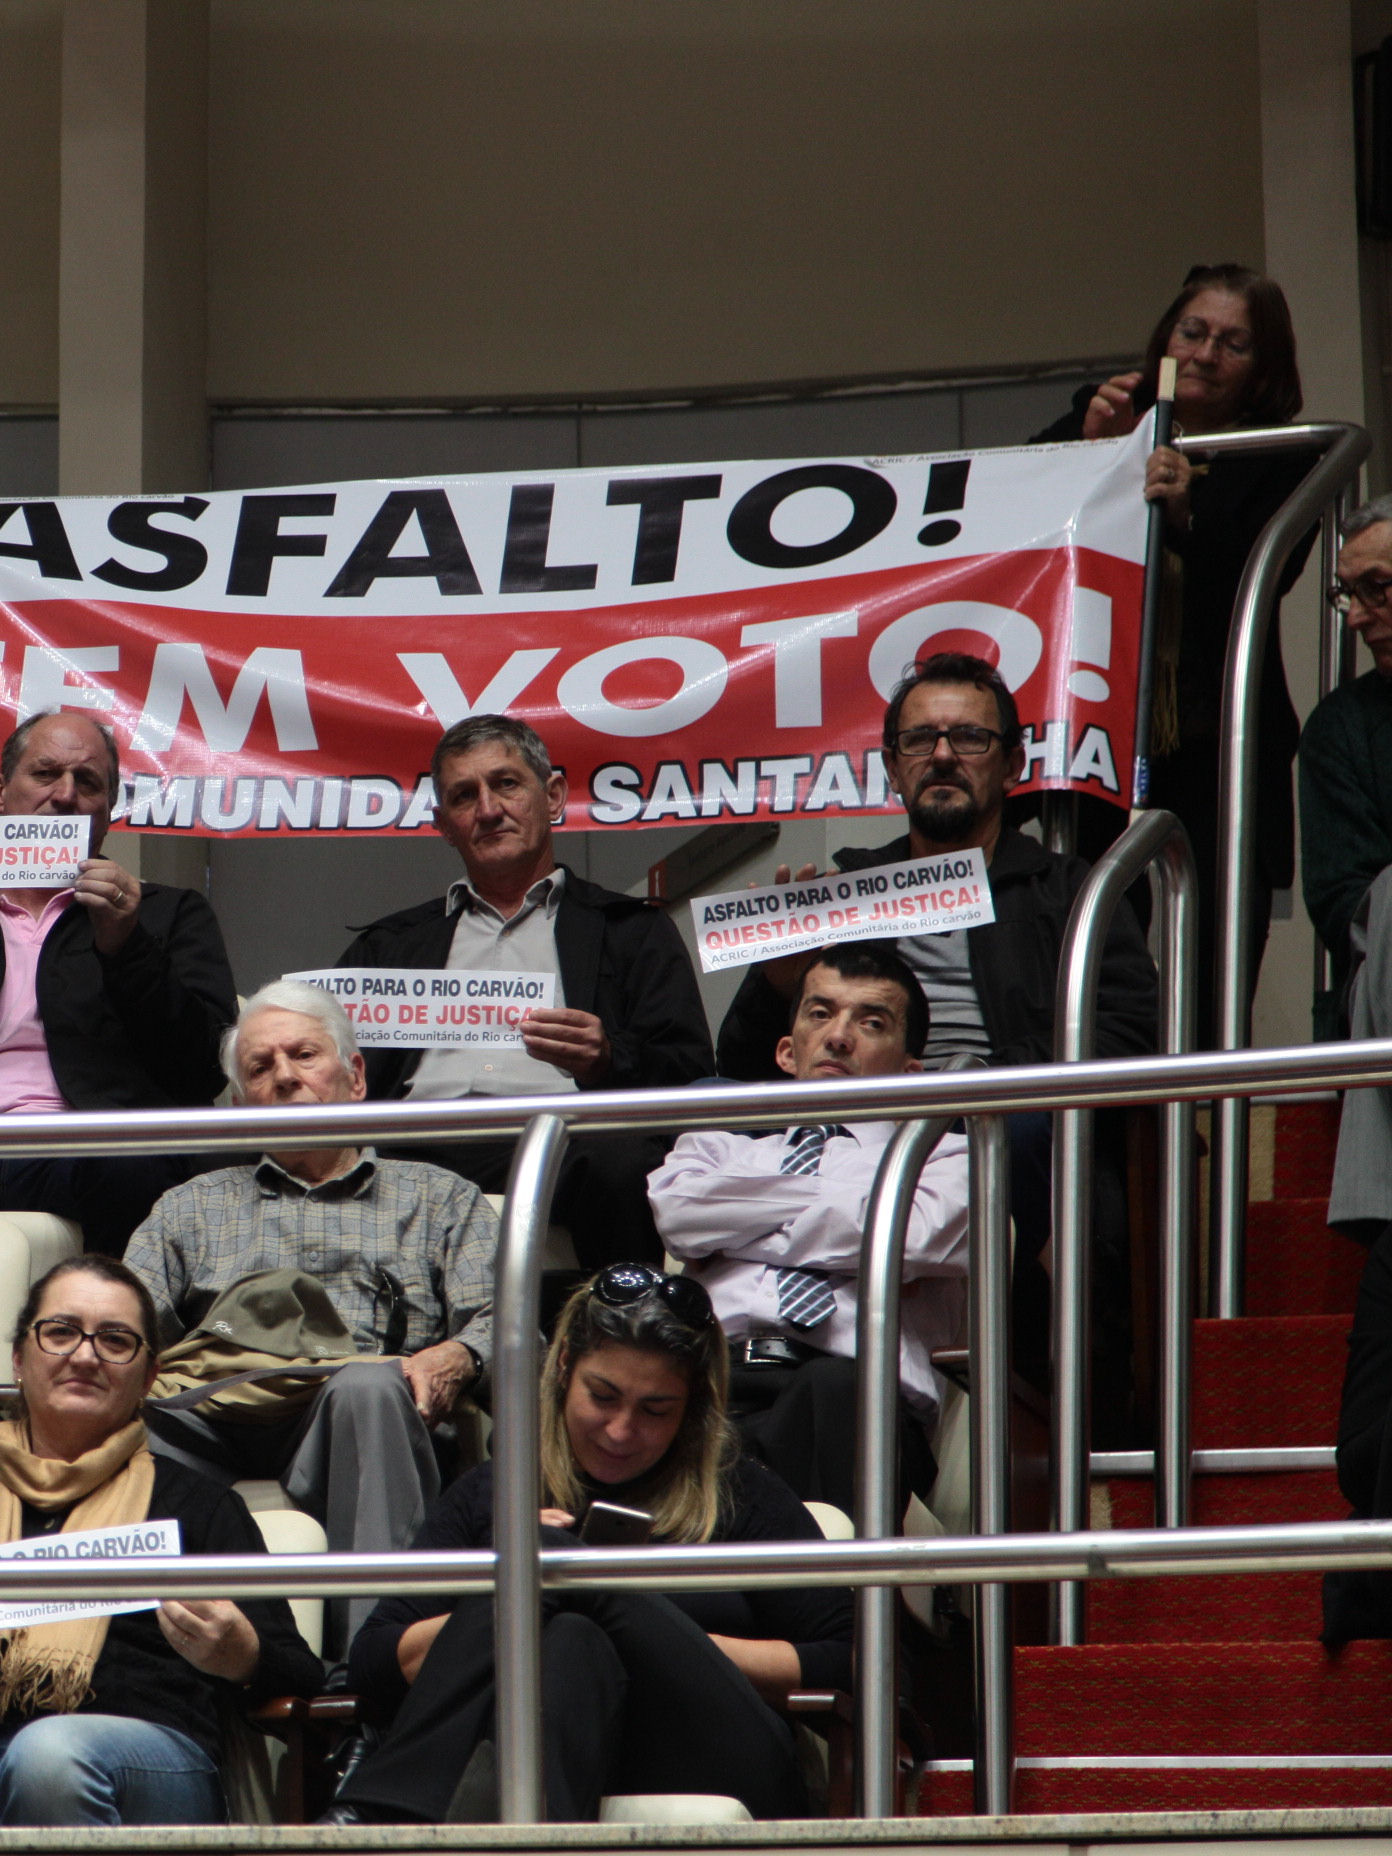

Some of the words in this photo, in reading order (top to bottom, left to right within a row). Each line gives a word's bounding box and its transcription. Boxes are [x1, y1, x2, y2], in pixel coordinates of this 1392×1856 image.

[395, 587, 1113, 738] VOTO!
[4, 820, 79, 840] CARVÃO!
[1, 870, 15, 881] do
[18, 869, 37, 880] Rio
[39, 870, 76, 880] carvão
[704, 895, 780, 924] ASFALTO
[784, 886, 833, 909] PARA
[837, 882, 851, 900] O
[855, 875, 888, 897] RIO
[893, 858, 974, 890] CARVÃO!
[705, 911, 821, 950] QUESTÃO
[827, 906, 861, 929] DE
[869, 884, 981, 921] JUSTIÇA!
[711, 949, 750, 964] ACRIC
[760, 936, 825, 955] Associação
[827, 923, 899, 940] Comunitária
[902, 920, 917, 931] do
[920, 917, 940, 928] Rio
[942, 911, 981, 925] carvão
[362, 978, 408, 996] PARA
[413, 979, 426, 996] O
[431, 979, 461, 997] RIO
[466, 976, 544, 999] CARVÃO!
[399, 1004, 428, 1025] DE
[436, 1005, 534, 1032] JUSTIÇA
[355, 1030, 391, 1042] ciação
[393, 1030, 461, 1041] Comunitária
[465, 1030, 479, 1042] do
[482, 1031, 501, 1042] Rio
[75, 1529, 166, 1557] CARVÃO!
